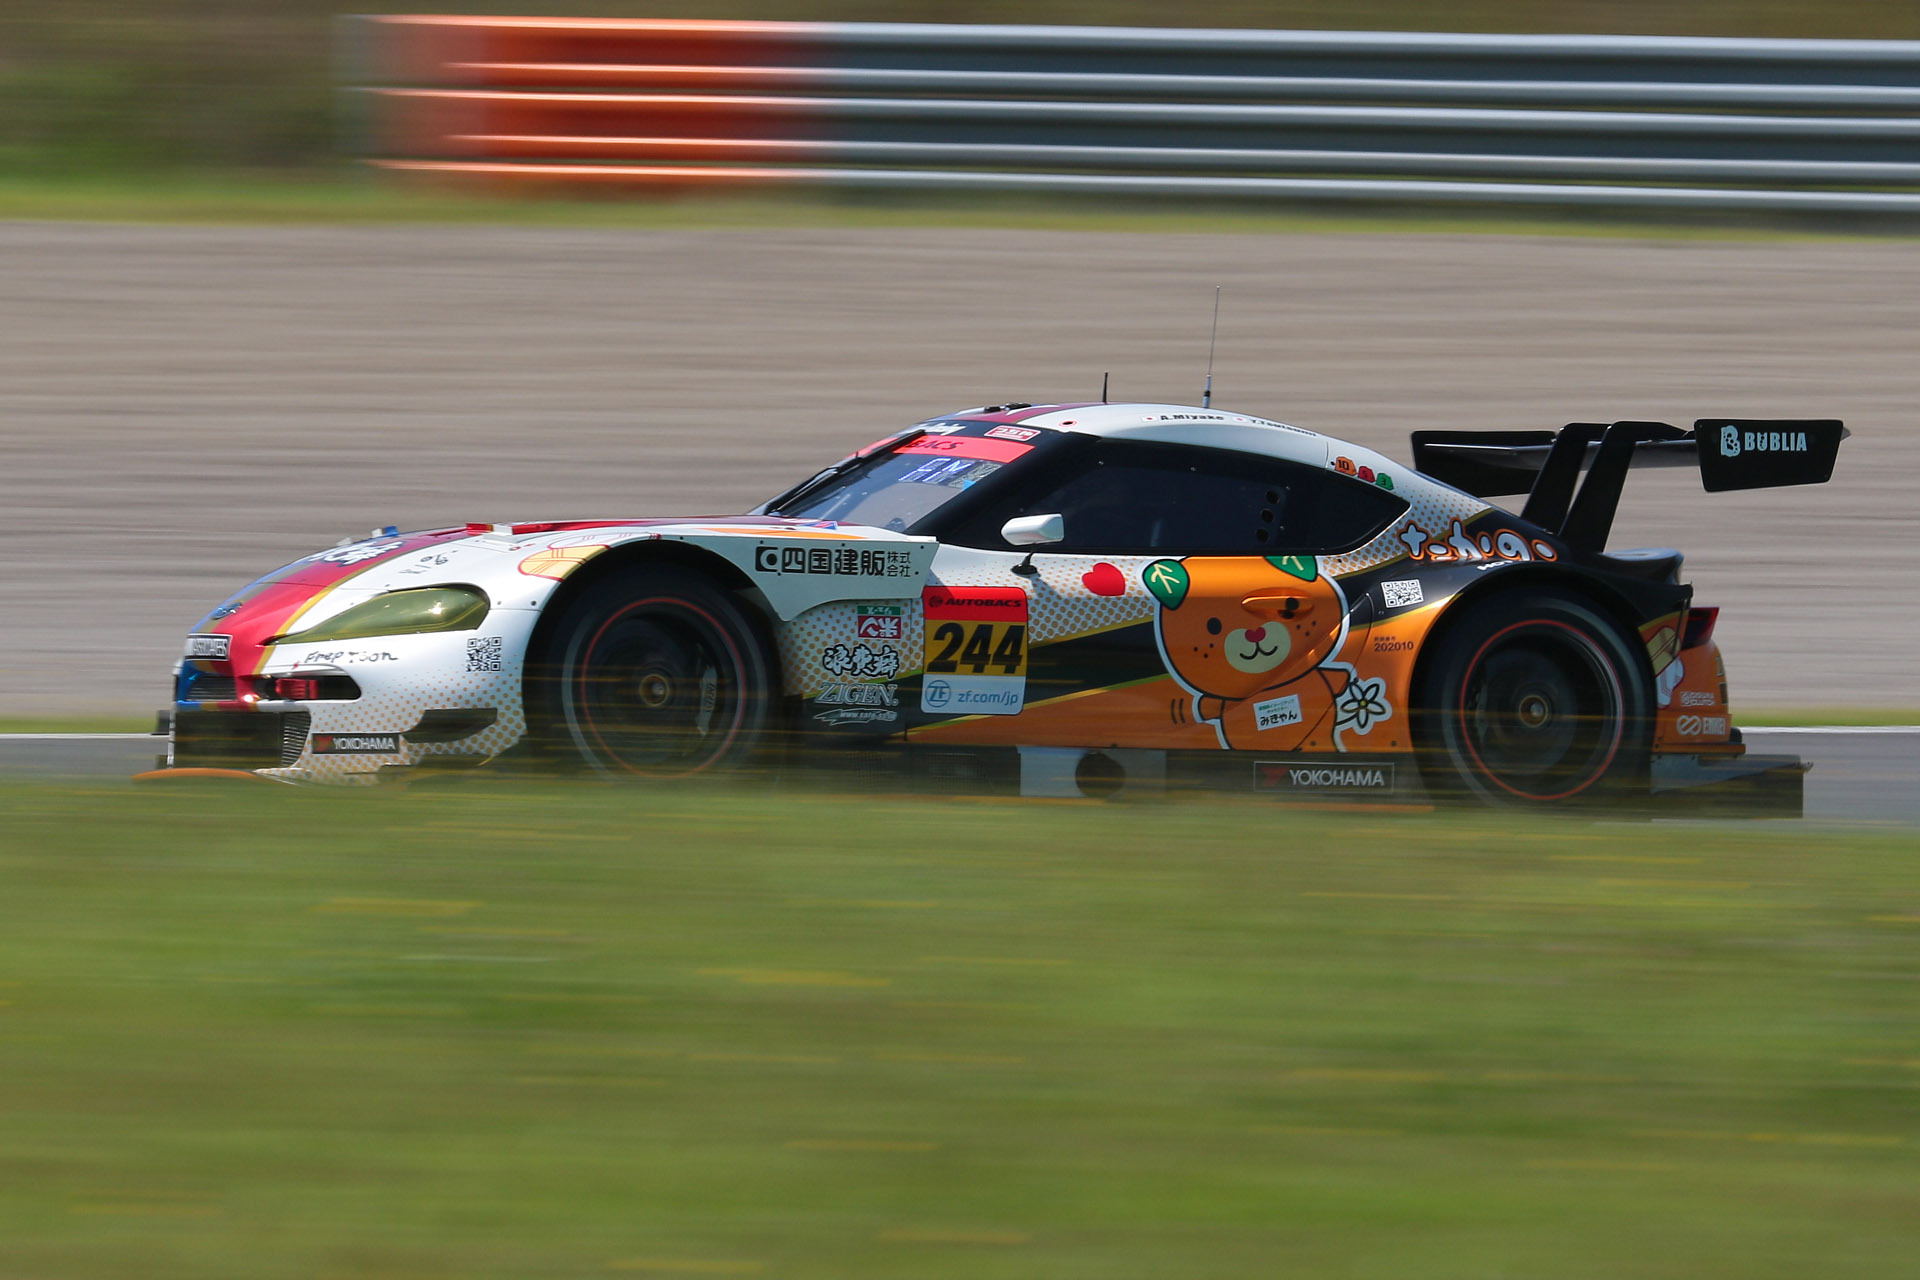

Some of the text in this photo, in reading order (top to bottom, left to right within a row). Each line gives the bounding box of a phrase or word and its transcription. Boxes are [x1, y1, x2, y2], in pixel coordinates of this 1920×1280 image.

[1744, 432, 1807, 452] BUBLIA
[781, 547, 886, 576] 四国建販
[946, 598, 1022, 608] AUTOBACS
[926, 622, 1026, 675] 244
[1374, 641, 1414, 652] 202010
[957, 690, 1019, 706] zf.com/jp
[333, 737, 396, 750] YOKOHAMA
[1289, 769, 1385, 786] YOKOHAMA
